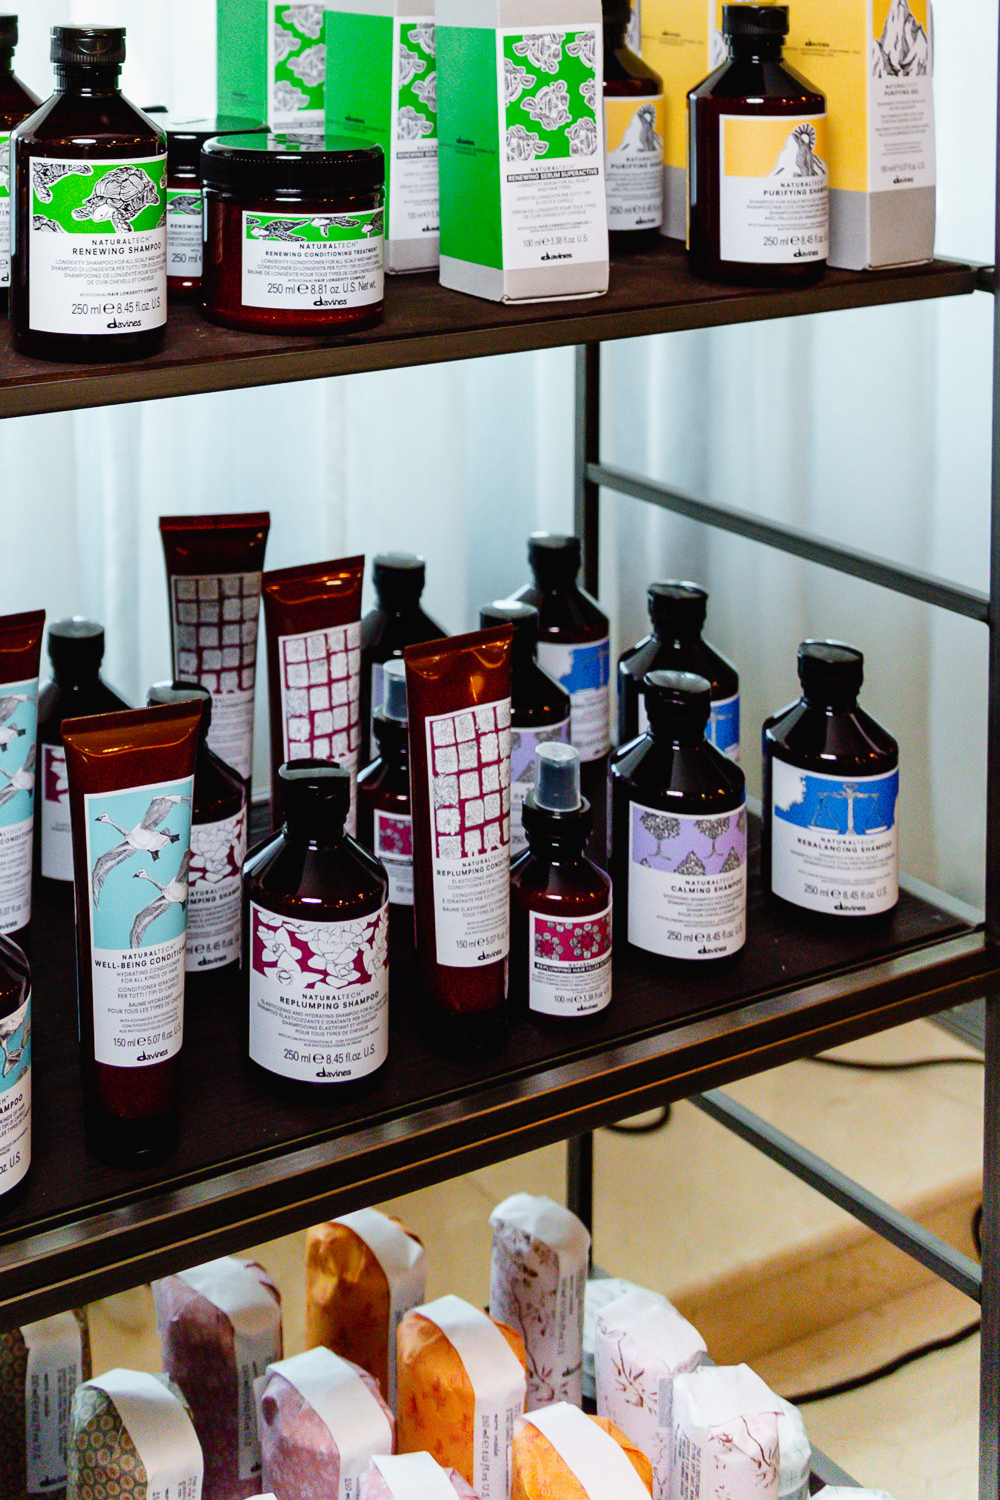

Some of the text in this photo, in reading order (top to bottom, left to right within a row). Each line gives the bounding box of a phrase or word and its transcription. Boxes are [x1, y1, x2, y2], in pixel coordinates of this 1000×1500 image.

[73, 242, 161, 256] RENEWING SHAMPOO
[354, 247, 378, 255] TREATMENT
[541, 252, 572, 260] davines
[268, 284, 327, 295] 250 8.81
[313, 296, 347, 306] davines
[72, 302, 134, 315] 250 8.45
[107, 318, 141, 329] davines
[797, 837, 858, 853] REBALANCING
[436, 867, 485, 877] REPLUMPING
[671, 878, 743, 894] CALMING SHAMPOO
[667, 930, 681, 942] 250
[478, 949, 502, 961] davines
[95, 960, 147, 969] WELL-BEING
[280, 991, 379, 1010] REPLUMPING SHAMPOO
[137, 1048, 168, 1062] davines
[284, 1049, 344, 1064] 250 8.45
[316, 1067, 352, 1078] davines
